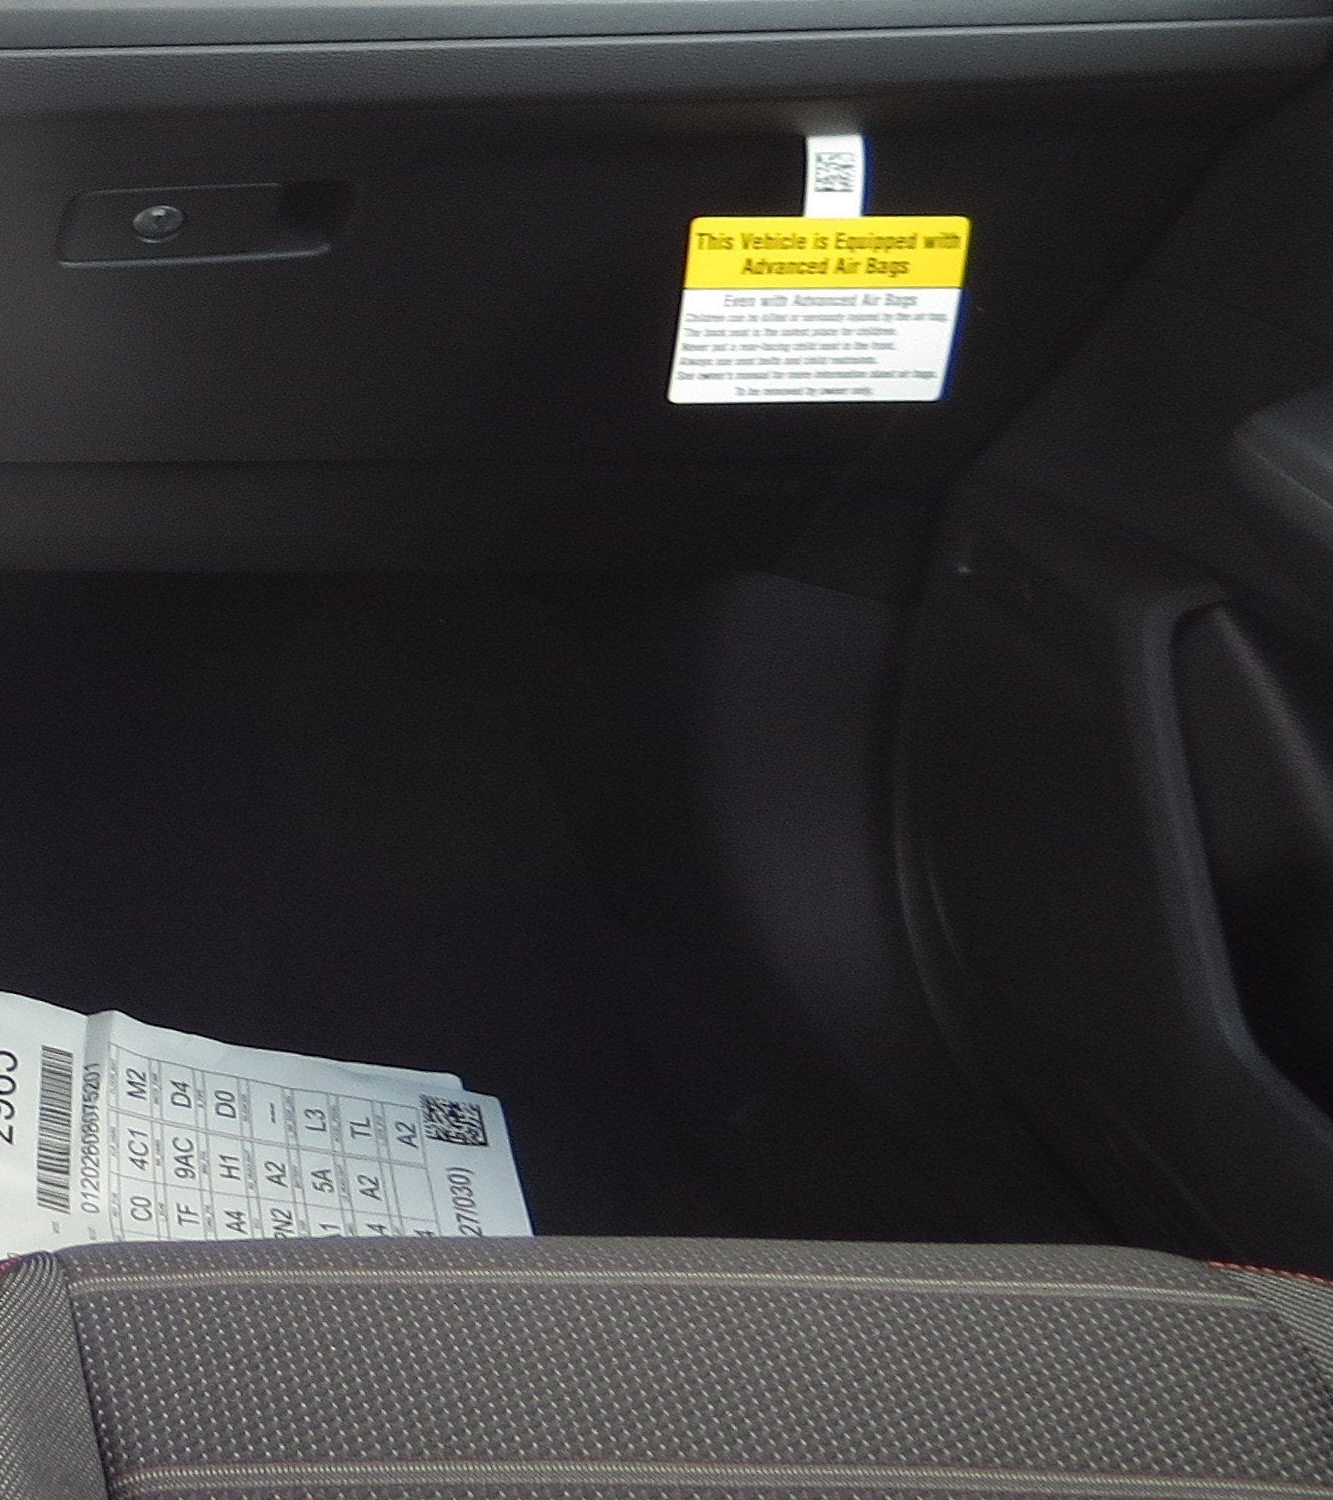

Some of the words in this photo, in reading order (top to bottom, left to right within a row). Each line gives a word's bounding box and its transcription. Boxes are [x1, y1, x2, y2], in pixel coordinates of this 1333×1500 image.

[696, 233, 733, 250] This
[741, 233, 807, 250] Vehicle
[814, 233, 829, 250] is
[834, 233, 918, 252] Equipped
[923, 233, 961, 250] with
[741, 258, 830, 275] Advanced
[834, 258, 860, 275] Air
[865, 258, 910, 277] Bags
[126, 1068, 147, 1100] M2
[170, 1080, 193, 1109] D4
[303, 1108, 327, 1132] L3
[349, 1116, 372, 1139] TL
[394, 1121, 419, 1149] A2
[127, 1128, 150, 1171] 4C1
[172, 1136, 196, 1180] 9AC
[218, 1154, 241, 1181] H1
[264, 1160, 288, 1188] A2
[311, 1168, 334, 1194] 5A
[356, 1174, 383, 1202] A2
[176, 1202, 200, 1226] TF
[224, 1209, 248, 1235] A4
